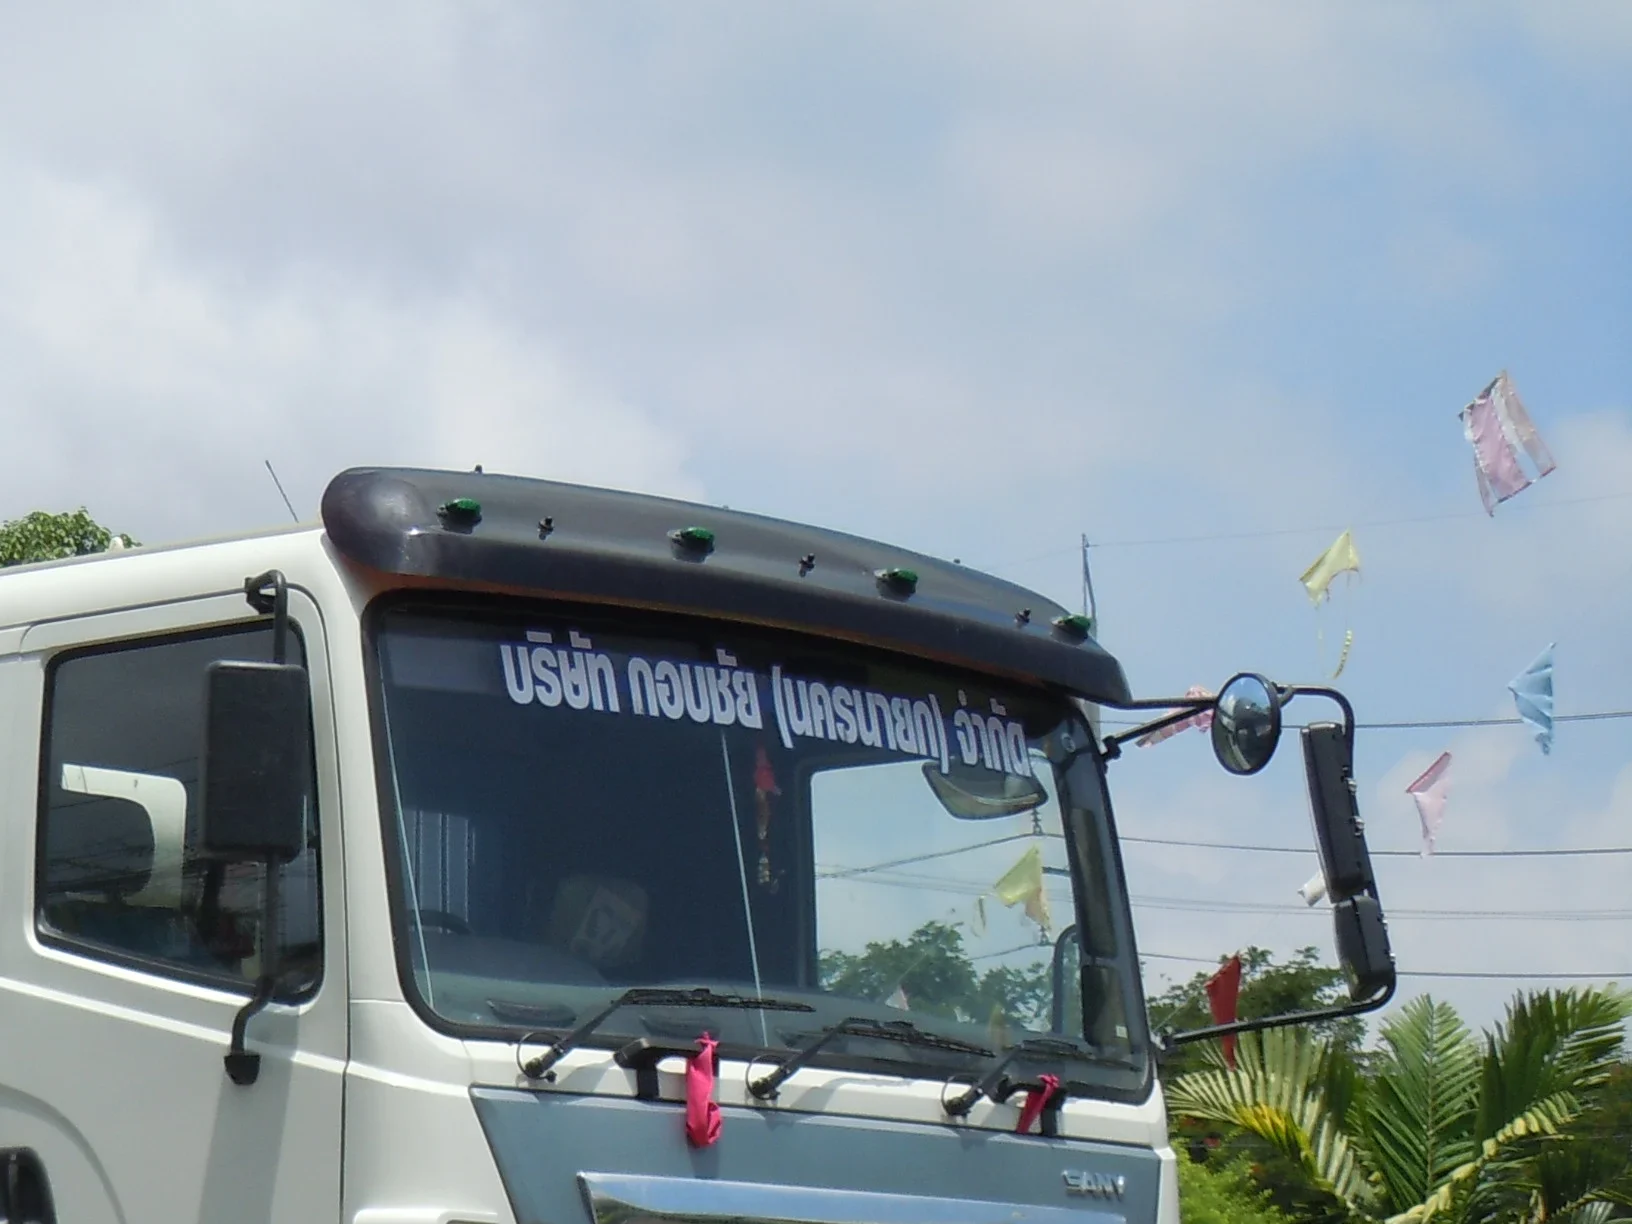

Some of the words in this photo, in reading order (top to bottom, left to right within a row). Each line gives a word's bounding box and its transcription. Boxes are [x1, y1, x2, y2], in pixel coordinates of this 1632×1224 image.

[499, 630, 620, 713] บริษัท
[627, 648, 763, 730] กอบชัย
[771, 664, 950, 775] (นครนายก)
[953, 689, 1033, 778] จำกัด
